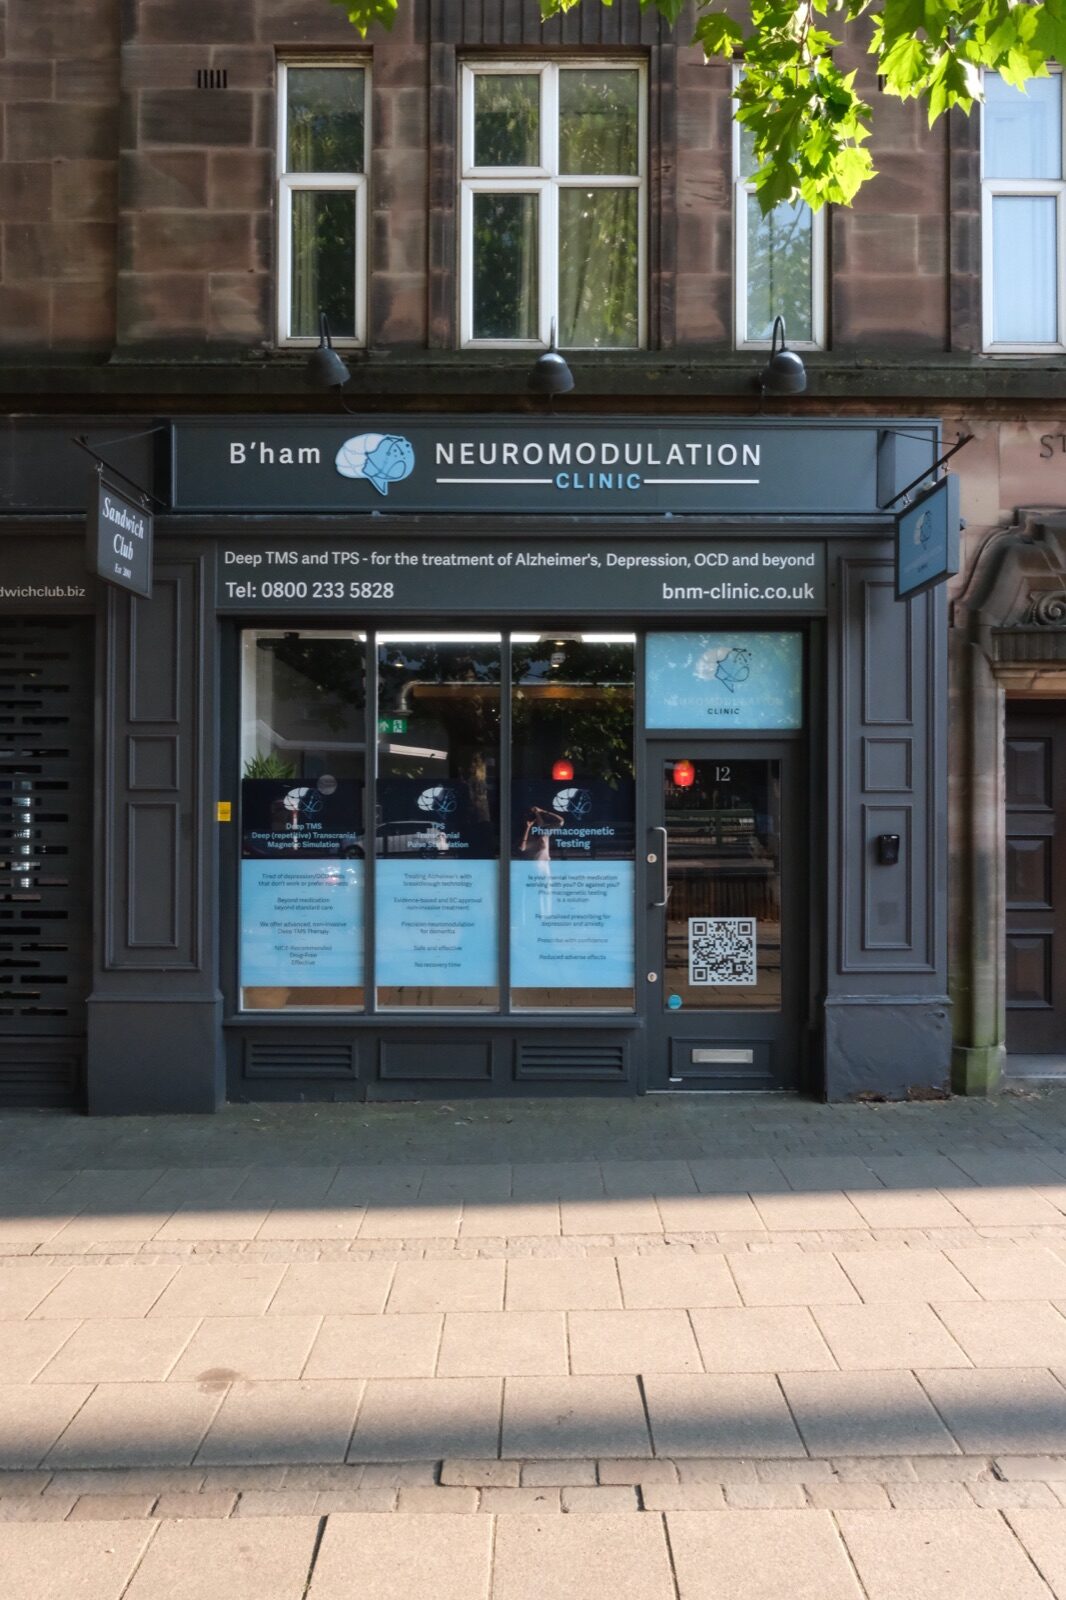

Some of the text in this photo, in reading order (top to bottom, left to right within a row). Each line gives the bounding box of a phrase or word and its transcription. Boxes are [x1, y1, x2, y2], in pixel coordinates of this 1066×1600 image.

[436, 442, 761, 466] NEUROMODULATION
[555, 472, 642, 490] CLINIC
[103, 497, 144, 539] Sandwich
[113, 534, 133, 560] Club
[224, 551, 262, 567] Deep
[265, 551, 298, 564] TMS
[301, 551, 329, 564] and
[331, 552, 360, 564] TPS
[371, 552, 391, 564] for
[395, 552, 418, 565] the
[422, 553, 494, 566] treatment
[498, 552, 514, 565] of
[515, 552, 602, 568] Alzheimer's,
[606, 554, 691, 569] Depression,
[694, 554, 729, 567] OCD
[732, 553, 759, 567] and
[762, 553, 815, 570] beyond
[225, 582, 394, 598] Tel: 0800 233 5828
[662, 582, 815, 600] bnm-clinic.co.uk
[715, 766, 731, 782] 12
[252, 832, 270, 840] Deep
[531, 826, 615, 837] Pharmacogenetic
[555, 838, 591, 850] Testing
